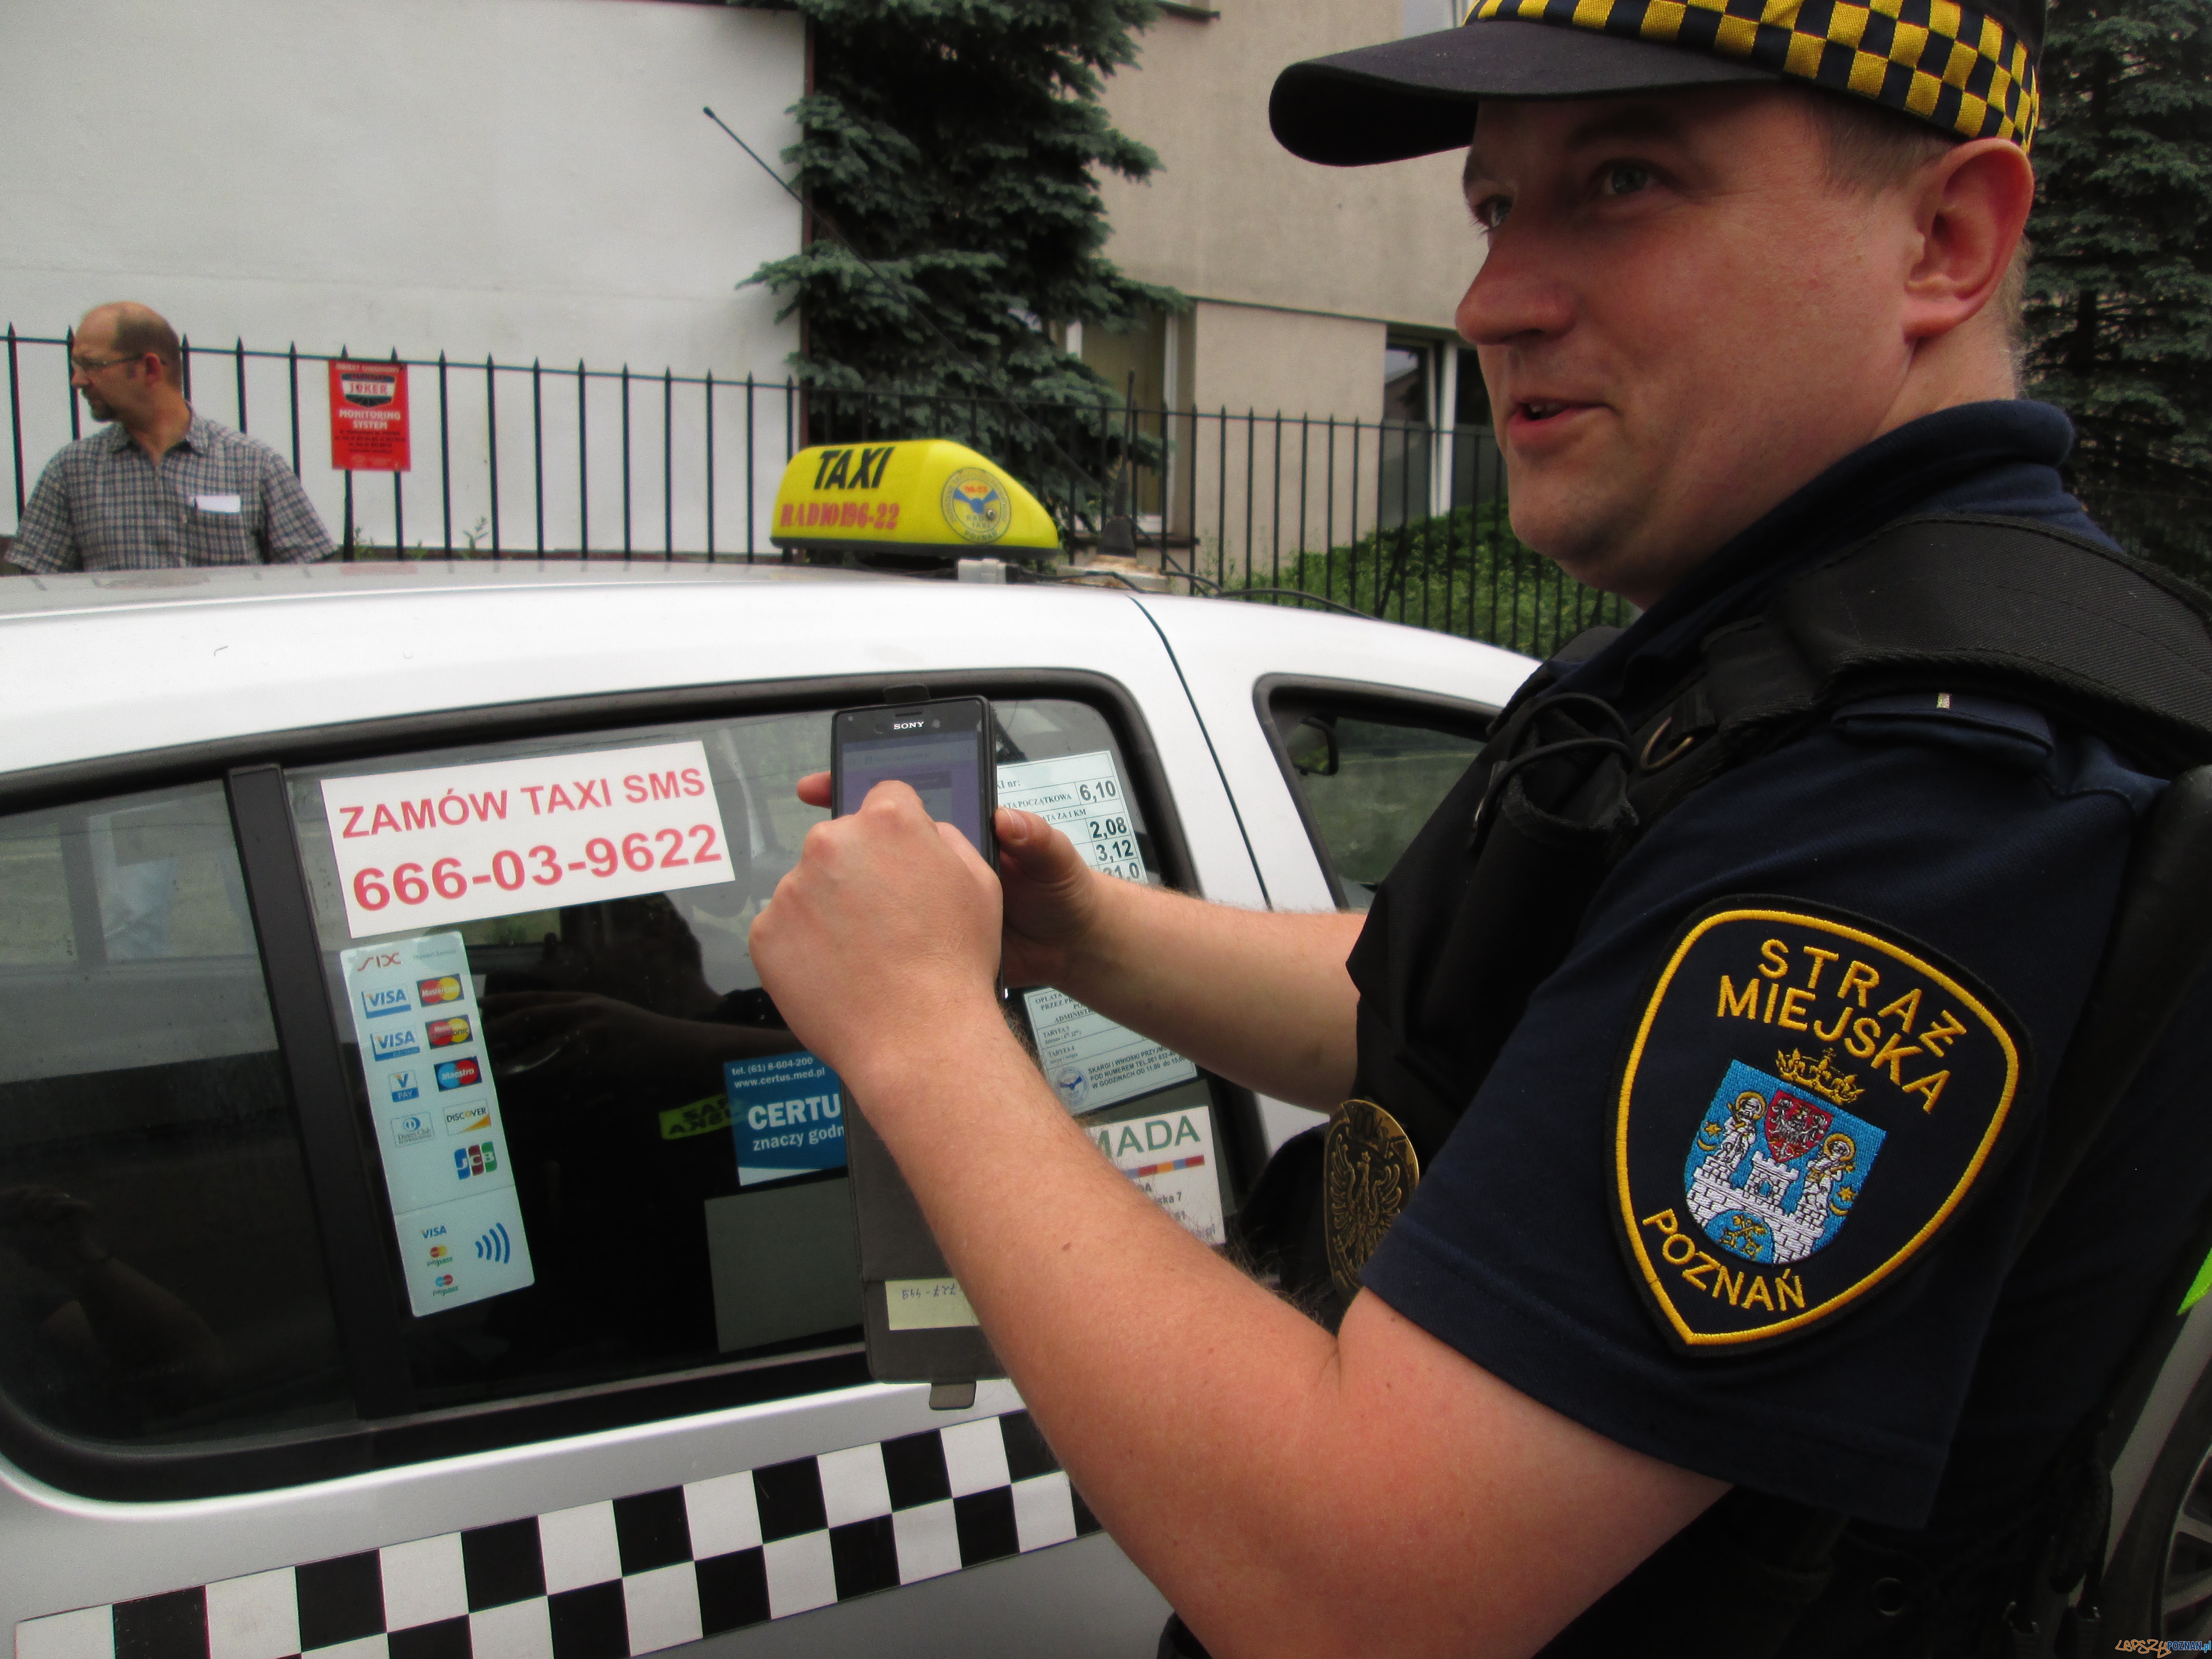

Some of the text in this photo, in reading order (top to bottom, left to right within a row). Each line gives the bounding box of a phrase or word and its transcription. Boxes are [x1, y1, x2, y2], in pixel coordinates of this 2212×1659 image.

[350, 383, 388, 395] JOKER
[339, 410, 401, 421] MONITORING
[353, 421, 388, 430] SYSTEM
[813, 446, 896, 491] TAXI
[893, 721, 925, 731] SONY
[1018, 793, 1072, 808] POCZĄTKOWA
[1079, 780, 1116, 803] 6,10
[339, 768, 706, 839] ZAMÓW TAXI SMS
[1057, 812, 1068, 820] ZA
[1073, 808, 1087, 817] KM
[1089, 817, 1127, 839] 2,08
[1096, 840, 1134, 863] 3,12
[353, 823, 722, 911] 666-03-9622
[367, 989, 407, 1008] VISA
[1040, 1000, 1063, 1010] PRZEZ
[1758, 938, 1967, 1058] STRAŻ
[375, 1031, 416, 1049] VISA
[1716, 974, 1951, 1115] MIEJSKA
[732, 1057, 814, 1076] tel. (61) 8-604-200
[1088, 1062, 1112, 1074] SKARGI
[1115, 1053, 1140, 1066] WNIOSKI
[1090, 1073, 1103, 1081] POD
[1105, 1064, 1134, 1078] NUMEREM
[442, 1068, 475, 1081] Maestro
[734, 1067, 826, 1088] www.certus.med.pl
[1099, 1071, 1135, 1087] GODZINACH
[398, 1091, 413, 1100] PAY
[446, 1107, 487, 1123] DISCOVER
[747, 1094, 841, 1130] CERTU
[417, 1128, 432, 1136] Club
[753, 1132, 804, 1152] znaczy
[1177, 1191, 1182, 1202] 7
[420, 1225, 447, 1239] VISA
[1642, 1208, 1806, 1312] POZNAŃ
